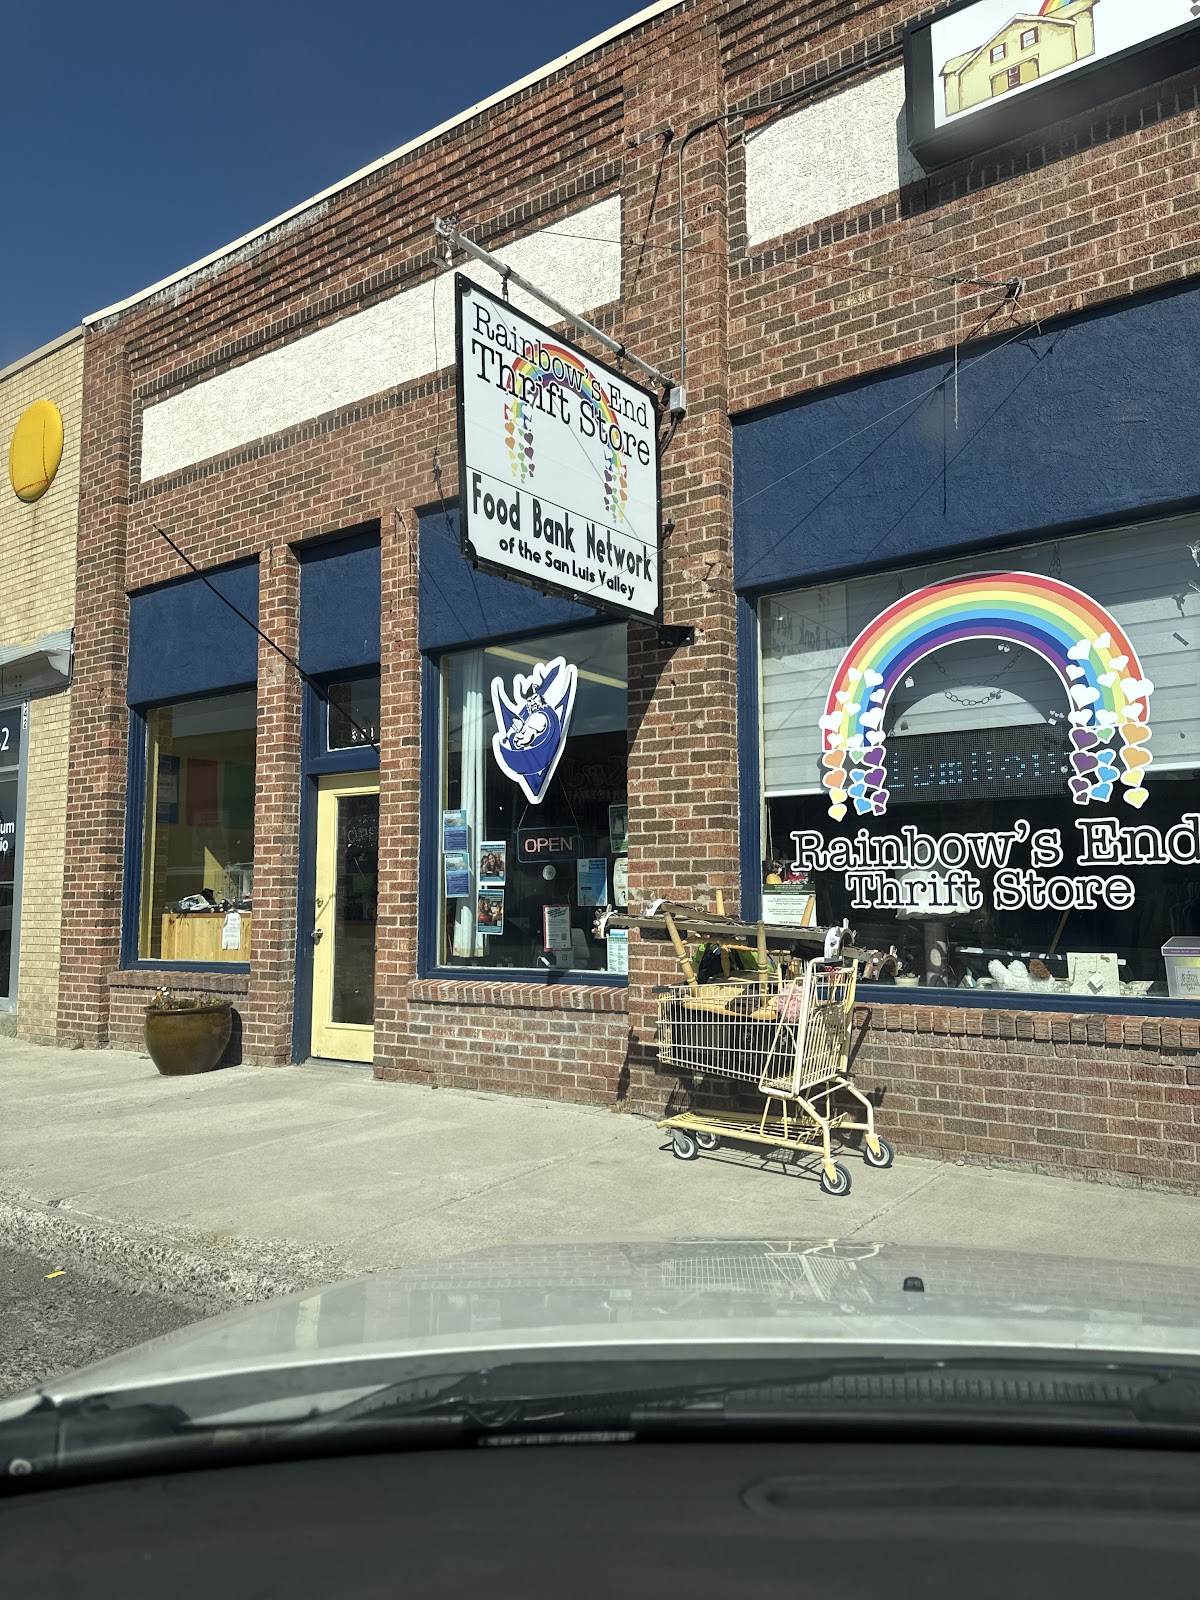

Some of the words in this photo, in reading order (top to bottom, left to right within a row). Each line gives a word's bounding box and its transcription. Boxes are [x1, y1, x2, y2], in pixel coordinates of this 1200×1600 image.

[472, 301, 602, 401] Rainbow's
[607, 381, 649, 430] End
[472, 338, 571, 425] Thrift
[580, 401, 650, 467] Store
[472, 471, 521, 533] Food
[533, 498, 576, 554] Bank
[587, 522, 653, 583] Network
[499, 537, 514, 554] of
[518, 541, 542, 565] the
[545, 551, 570, 576] San
[572, 559, 596, 585] Luis
[599, 568, 635, 601] Valley
[0, 727, 9, 751] 2
[524, 836, 573, 853] OPEN
[790, 819, 1063, 872] Rainbow's
[1076, 812, 1200, 866] End
[845, 869, 984, 910] Thrift
[992, 867, 1135, 911] Store
